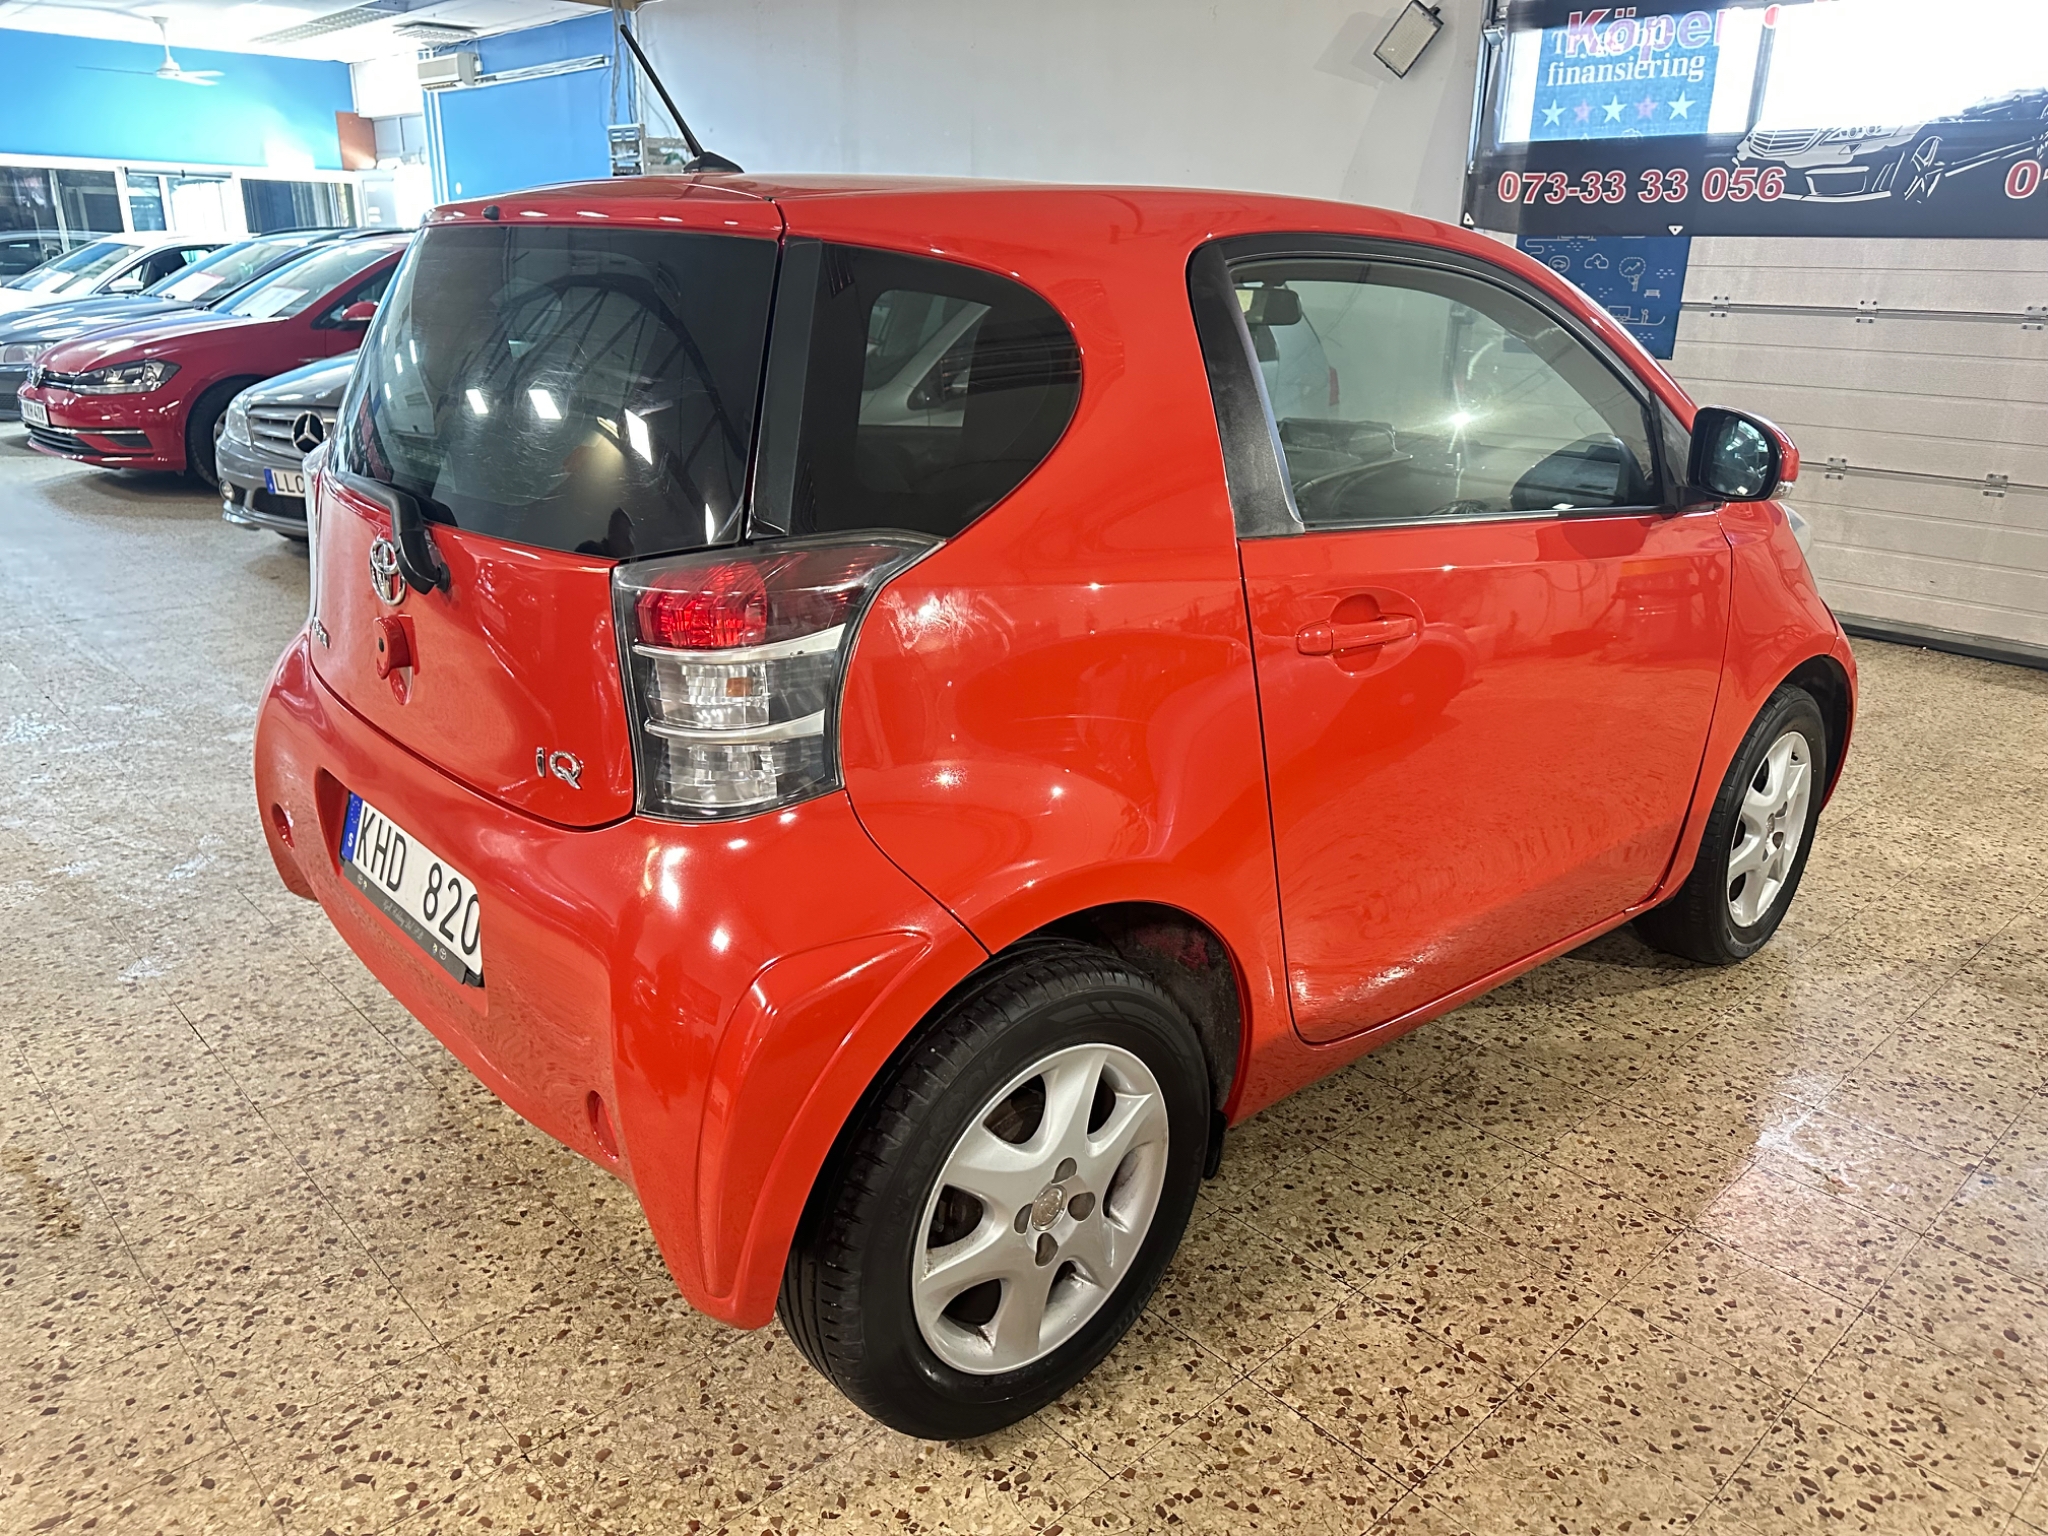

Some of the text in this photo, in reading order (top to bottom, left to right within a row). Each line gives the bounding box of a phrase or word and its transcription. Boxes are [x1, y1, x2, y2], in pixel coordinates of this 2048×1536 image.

[1546, 53, 1705, 87] finansiering
[1498, 167, 1788, 204] 073-33 33 056
[2004, 160, 2048, 199] 0
[356, 806, 407, 892] KHD
[423, 862, 480, 956] 820
